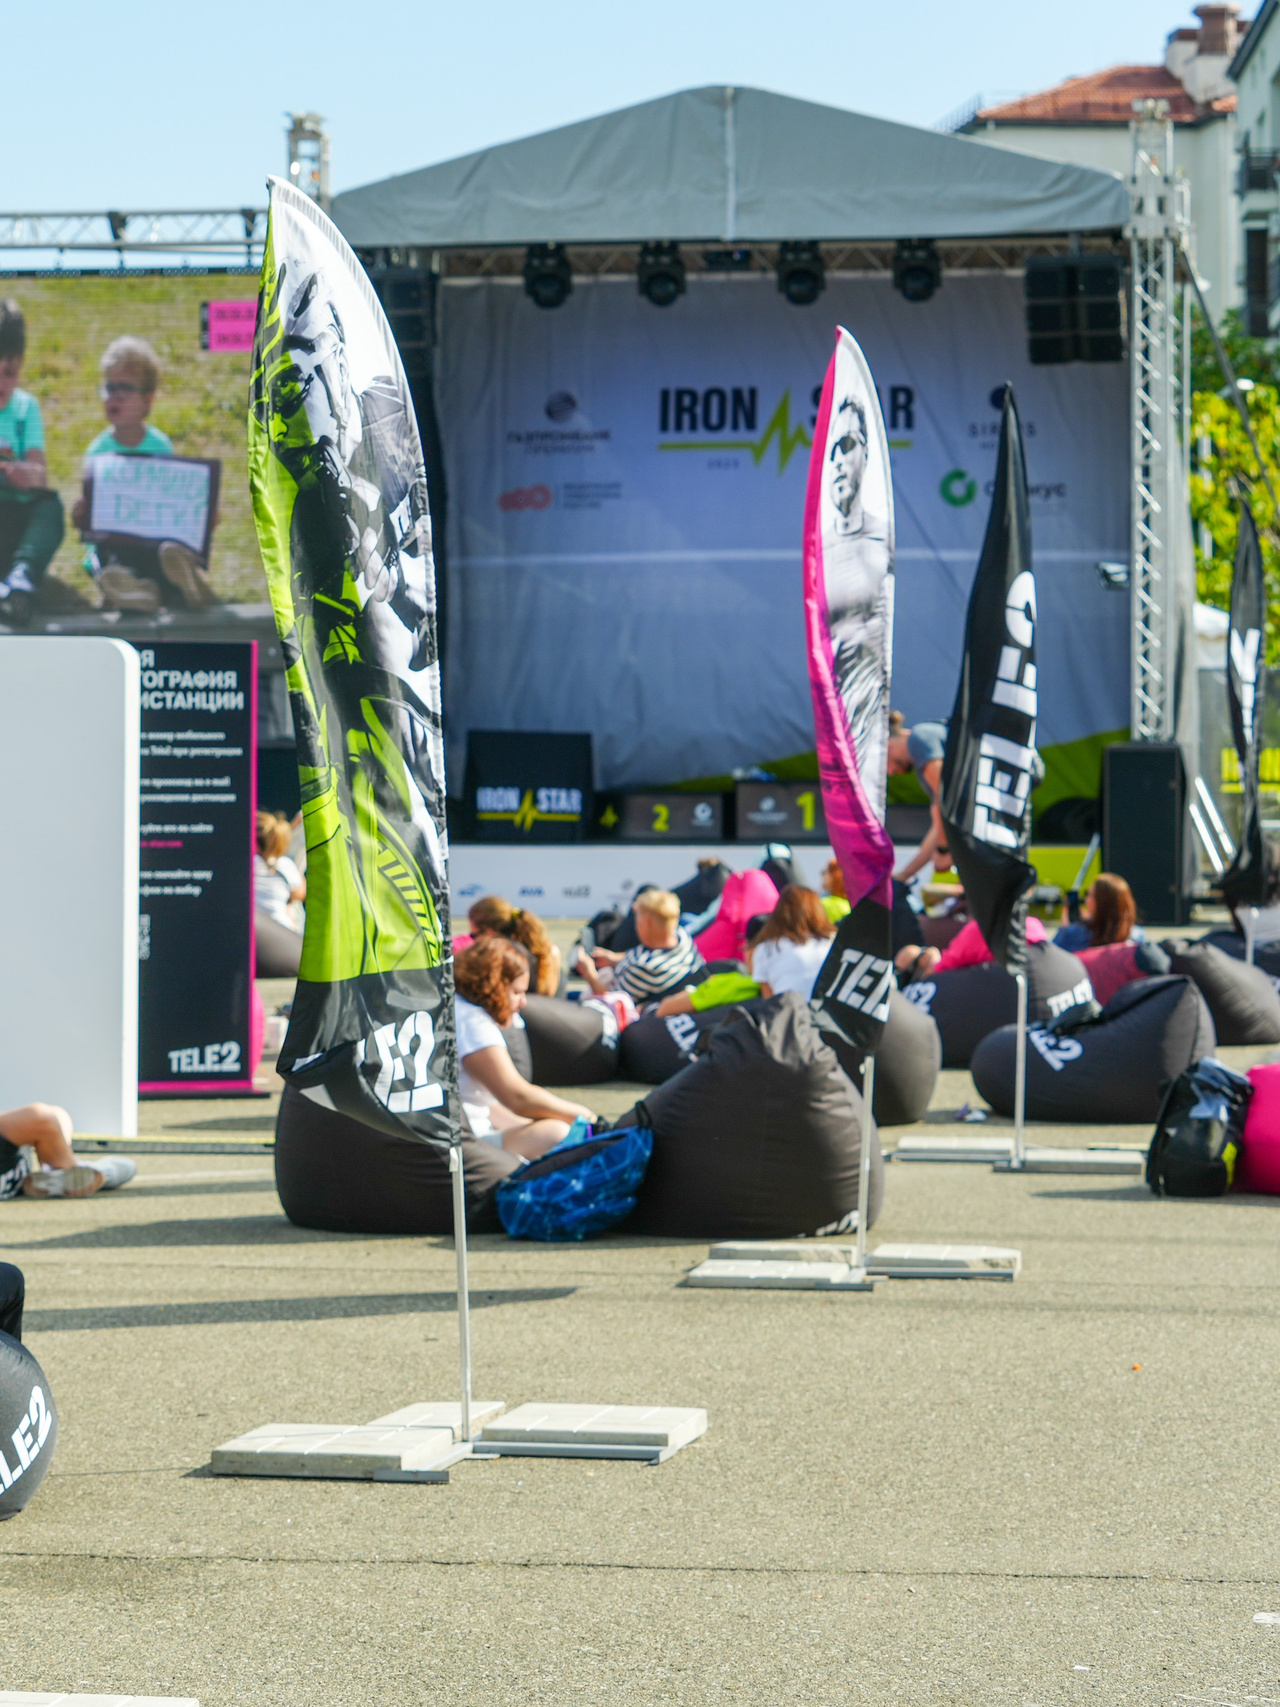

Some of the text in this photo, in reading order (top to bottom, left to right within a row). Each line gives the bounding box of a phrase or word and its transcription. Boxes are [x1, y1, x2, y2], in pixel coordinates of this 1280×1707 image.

[659, 386, 757, 433] IRON
[141, 670, 238, 690] ОГРАФИЯ
[140, 691, 244, 713] ИСТАНЦИИ
[476, 786, 583, 813] IRON STAR
[796, 791, 816, 831] 1
[652, 804, 670, 832] 2
[167, 1040, 242, 1074] TELE2
